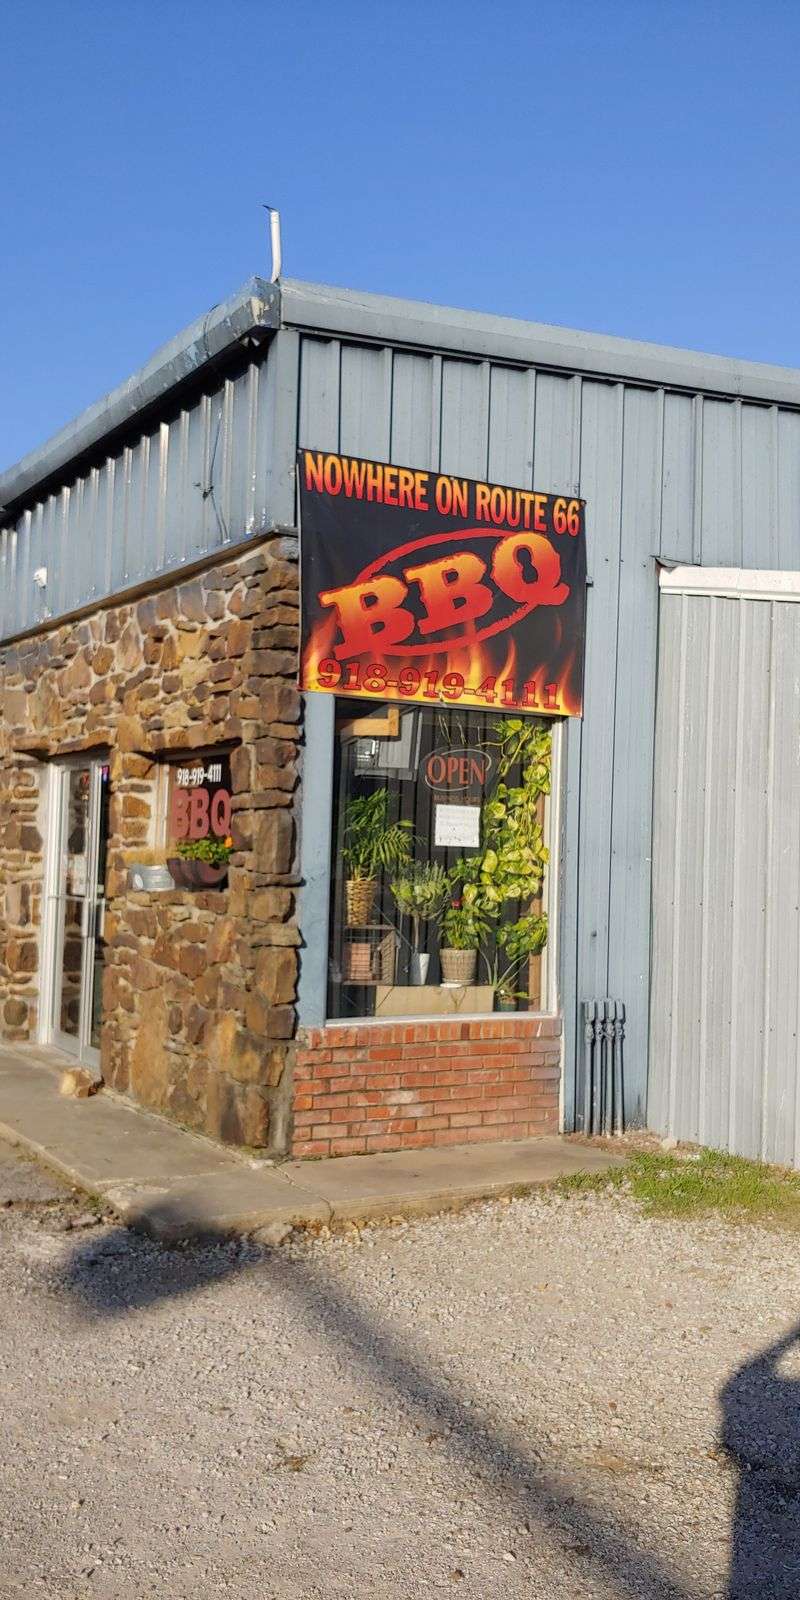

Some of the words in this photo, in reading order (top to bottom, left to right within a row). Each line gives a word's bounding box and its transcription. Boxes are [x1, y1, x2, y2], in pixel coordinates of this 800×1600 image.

[304, 452, 429, 511] NOWHERE
[435, 476, 469, 518] ON
[476, 486, 547, 532] ROUTE
[553, 498, 580, 536] 66
[318, 532, 571, 661] BBQ
[317, 657, 561, 710] 918-919-4111
[177, 764, 222, 786] 918-919-4111
[427, 755, 486, 785] OPEN
[172, 788, 232, 839] BBQ
